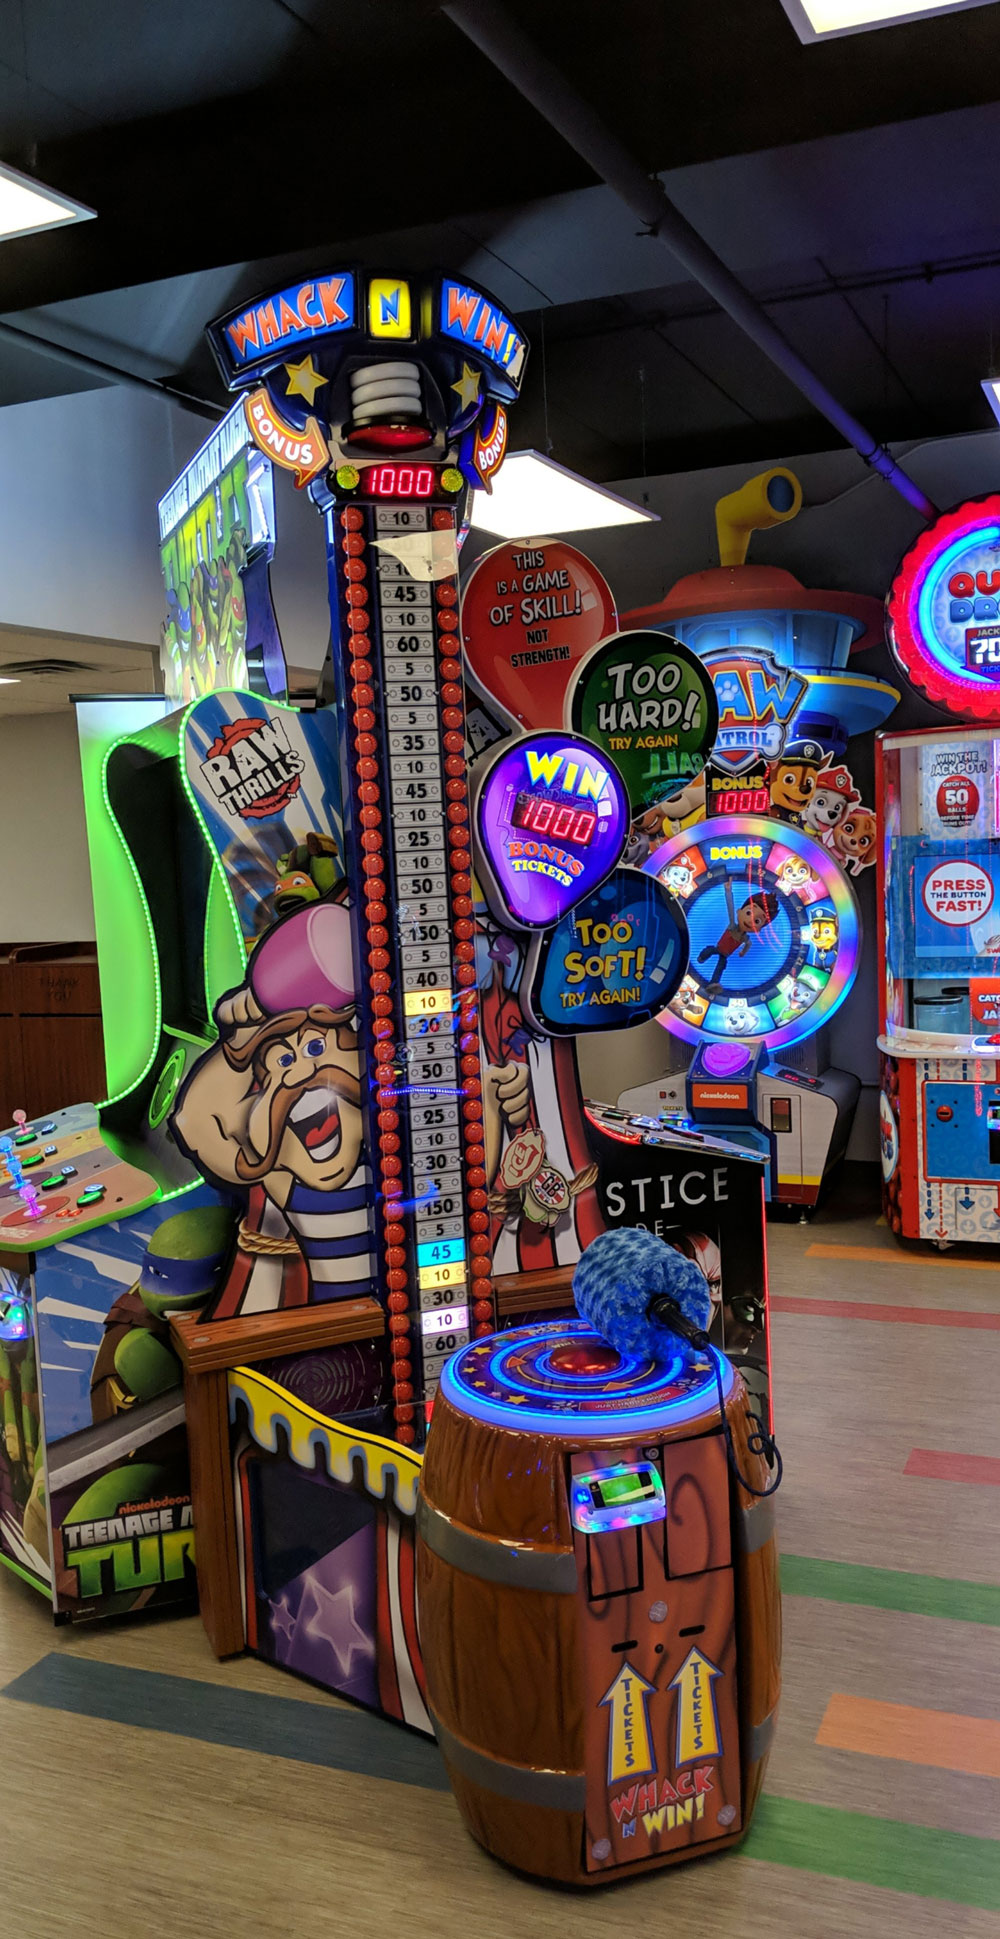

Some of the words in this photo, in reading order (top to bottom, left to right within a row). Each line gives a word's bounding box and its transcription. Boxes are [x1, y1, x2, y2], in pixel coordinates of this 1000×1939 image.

[227, 278, 349, 358] WHACK
[379, 288, 401, 325] N
[447, 287, 517, 364] WIN!
[252, 404, 313, 465] BONUS
[479, 415, 505, 471] BONUS
[371, 468, 432, 495] 1000
[393, 512, 410, 525] 10
[513, 551, 545, 570] THIS
[497, 582, 507, 595] IS
[511, 580, 519, 593] A
[523, 570, 570, 593] GAME
[395, 586, 416, 602] 45
[490, 604, 514, 626] OF
[520, 590, 581, 625] SKILL!
[950, 597, 1000, 623] DR
[399, 613, 415, 626] 10
[398, 636, 419, 652] 60
[526, 629, 548, 644] NOT
[511, 646, 570, 668] STRENGTH!
[406, 663, 414, 675] 5
[607, 662, 682, 700] TOO
[401, 686, 422, 701] 50
[713, 671, 808, 724] AW
[409, 712, 417, 724] 5
[598, 690, 700, 733] HARD!
[403, 736, 424, 751] 35
[609, 737, 632, 750] TRY
[635, 734, 679, 749] AGAIN
[716, 732, 772, 747] TROL
[200, 717, 292, 797] RAW
[936, 753, 955, 764] WIN
[958, 751, 978, 762] THE
[407, 761, 423, 773] 10
[931, 760, 987, 777] JACKPOT!
[219, 750, 305, 816] THRILLS
[406, 784, 427, 798] 45
[712, 777, 763, 791] BONUS
[716, 792, 767, 812] 1000
[946, 789, 969, 805] 50
[410, 809, 426, 821] 10
[524, 801, 595, 842] 1000
[408, 832, 429, 847] 25
[508, 842, 584, 877] BONUS
[710, 846, 762, 860] BONUS
[413, 857, 429, 869] 10
[512, 860, 573, 887] TICKETS
[412, 879, 432, 894] 50
[932, 879, 986, 891] PRESS
[420, 904, 428, 916] 5
[936, 900, 982, 912] FAST!
[409, 926, 439, 941] 150
[576, 919, 632, 946] TOO
[422, 951, 430, 962] 5
[565, 947, 646, 984] SOFT!
[417, 972, 437, 987] 40
[421, 996, 436, 1008] 10
[560, 992, 586, 1008] TRY
[590, 988, 640, 1006] AGAIN!
[419, 1018, 439, 1033] 30
[427, 1042, 434, 1054] 5
[422, 1063, 442, 1079] 50
[424, 1109, 444, 1124] 25
[428, 1133, 443, 1146] 10
[426, 1154, 447, 1170] 30
[434, 1179, 442, 1190] 5
[606, 1168, 729, 1217] STICE
[425, 1199, 454, 1215] 150
[436, 1224, 444, 1236] 5
[432, 1245, 451, 1260] 45
[435, 1269, 450, 1281] 10
[433, 1290, 453, 1306] 30
[438, 1314, 452, 1327] 10
[436, 1335, 456, 1351] 60
[119, 1496, 190, 1515] nickelodeon
[65, 1510, 173, 1548] TEENAGE
[690, 1662, 703, 1750] TICKETS
[621, 1678, 635, 1767] TICKETS
[610, 1766, 714, 1823] WHACK
[623, 1818, 637, 1838] N
[642, 1793, 705, 1837] WIN!
